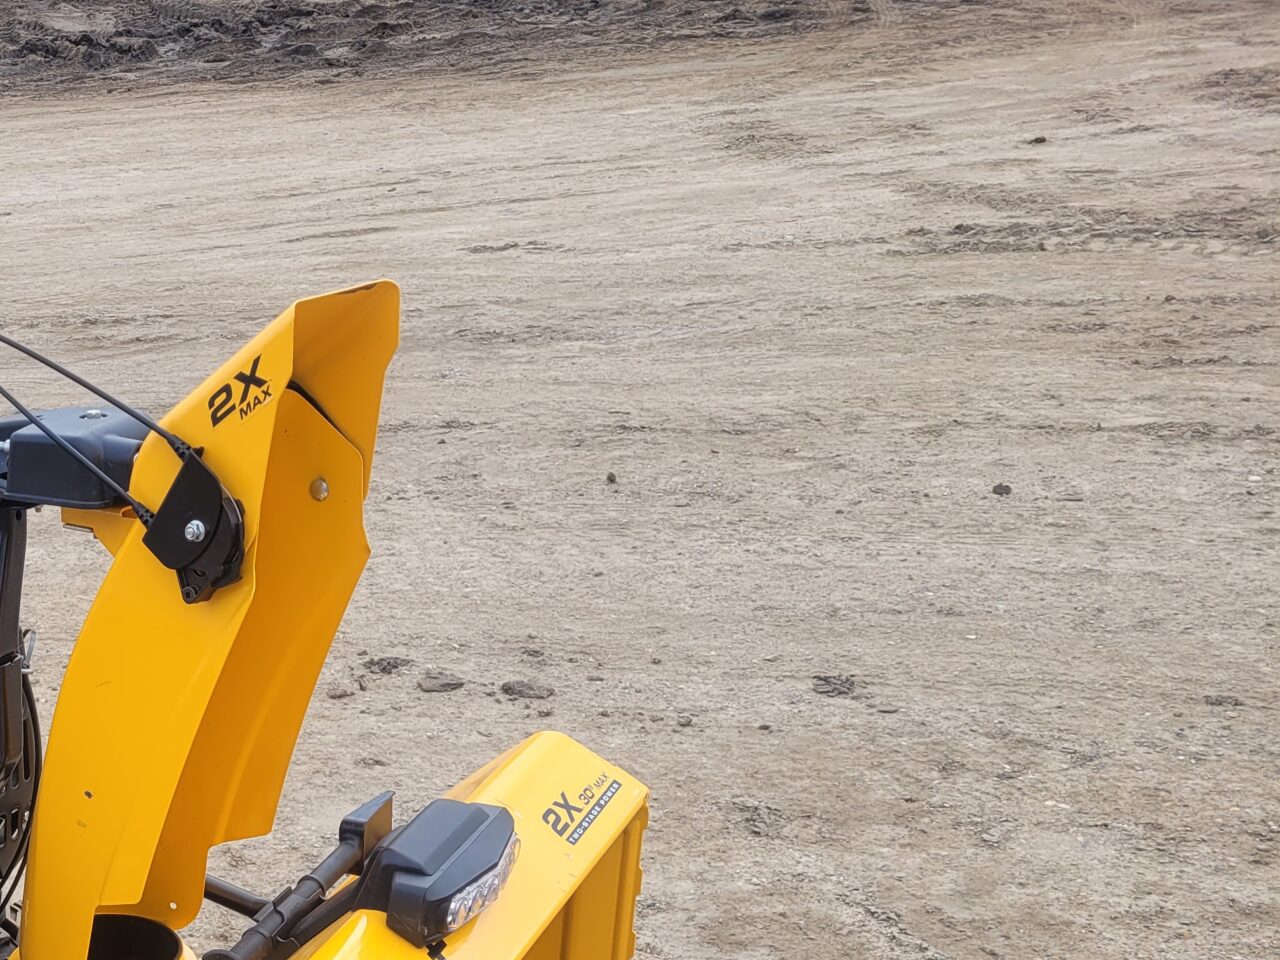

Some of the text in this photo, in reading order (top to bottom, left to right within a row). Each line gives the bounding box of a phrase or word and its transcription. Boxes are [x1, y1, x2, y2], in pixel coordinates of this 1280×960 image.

[208, 353, 268, 428] 2X
[239, 384, 272, 421] MAX
[542, 791, 583, 837] 2X
[593, 772, 609, 790] MAX
[568, 782, 620, 843] TWO-STAGE POWER
